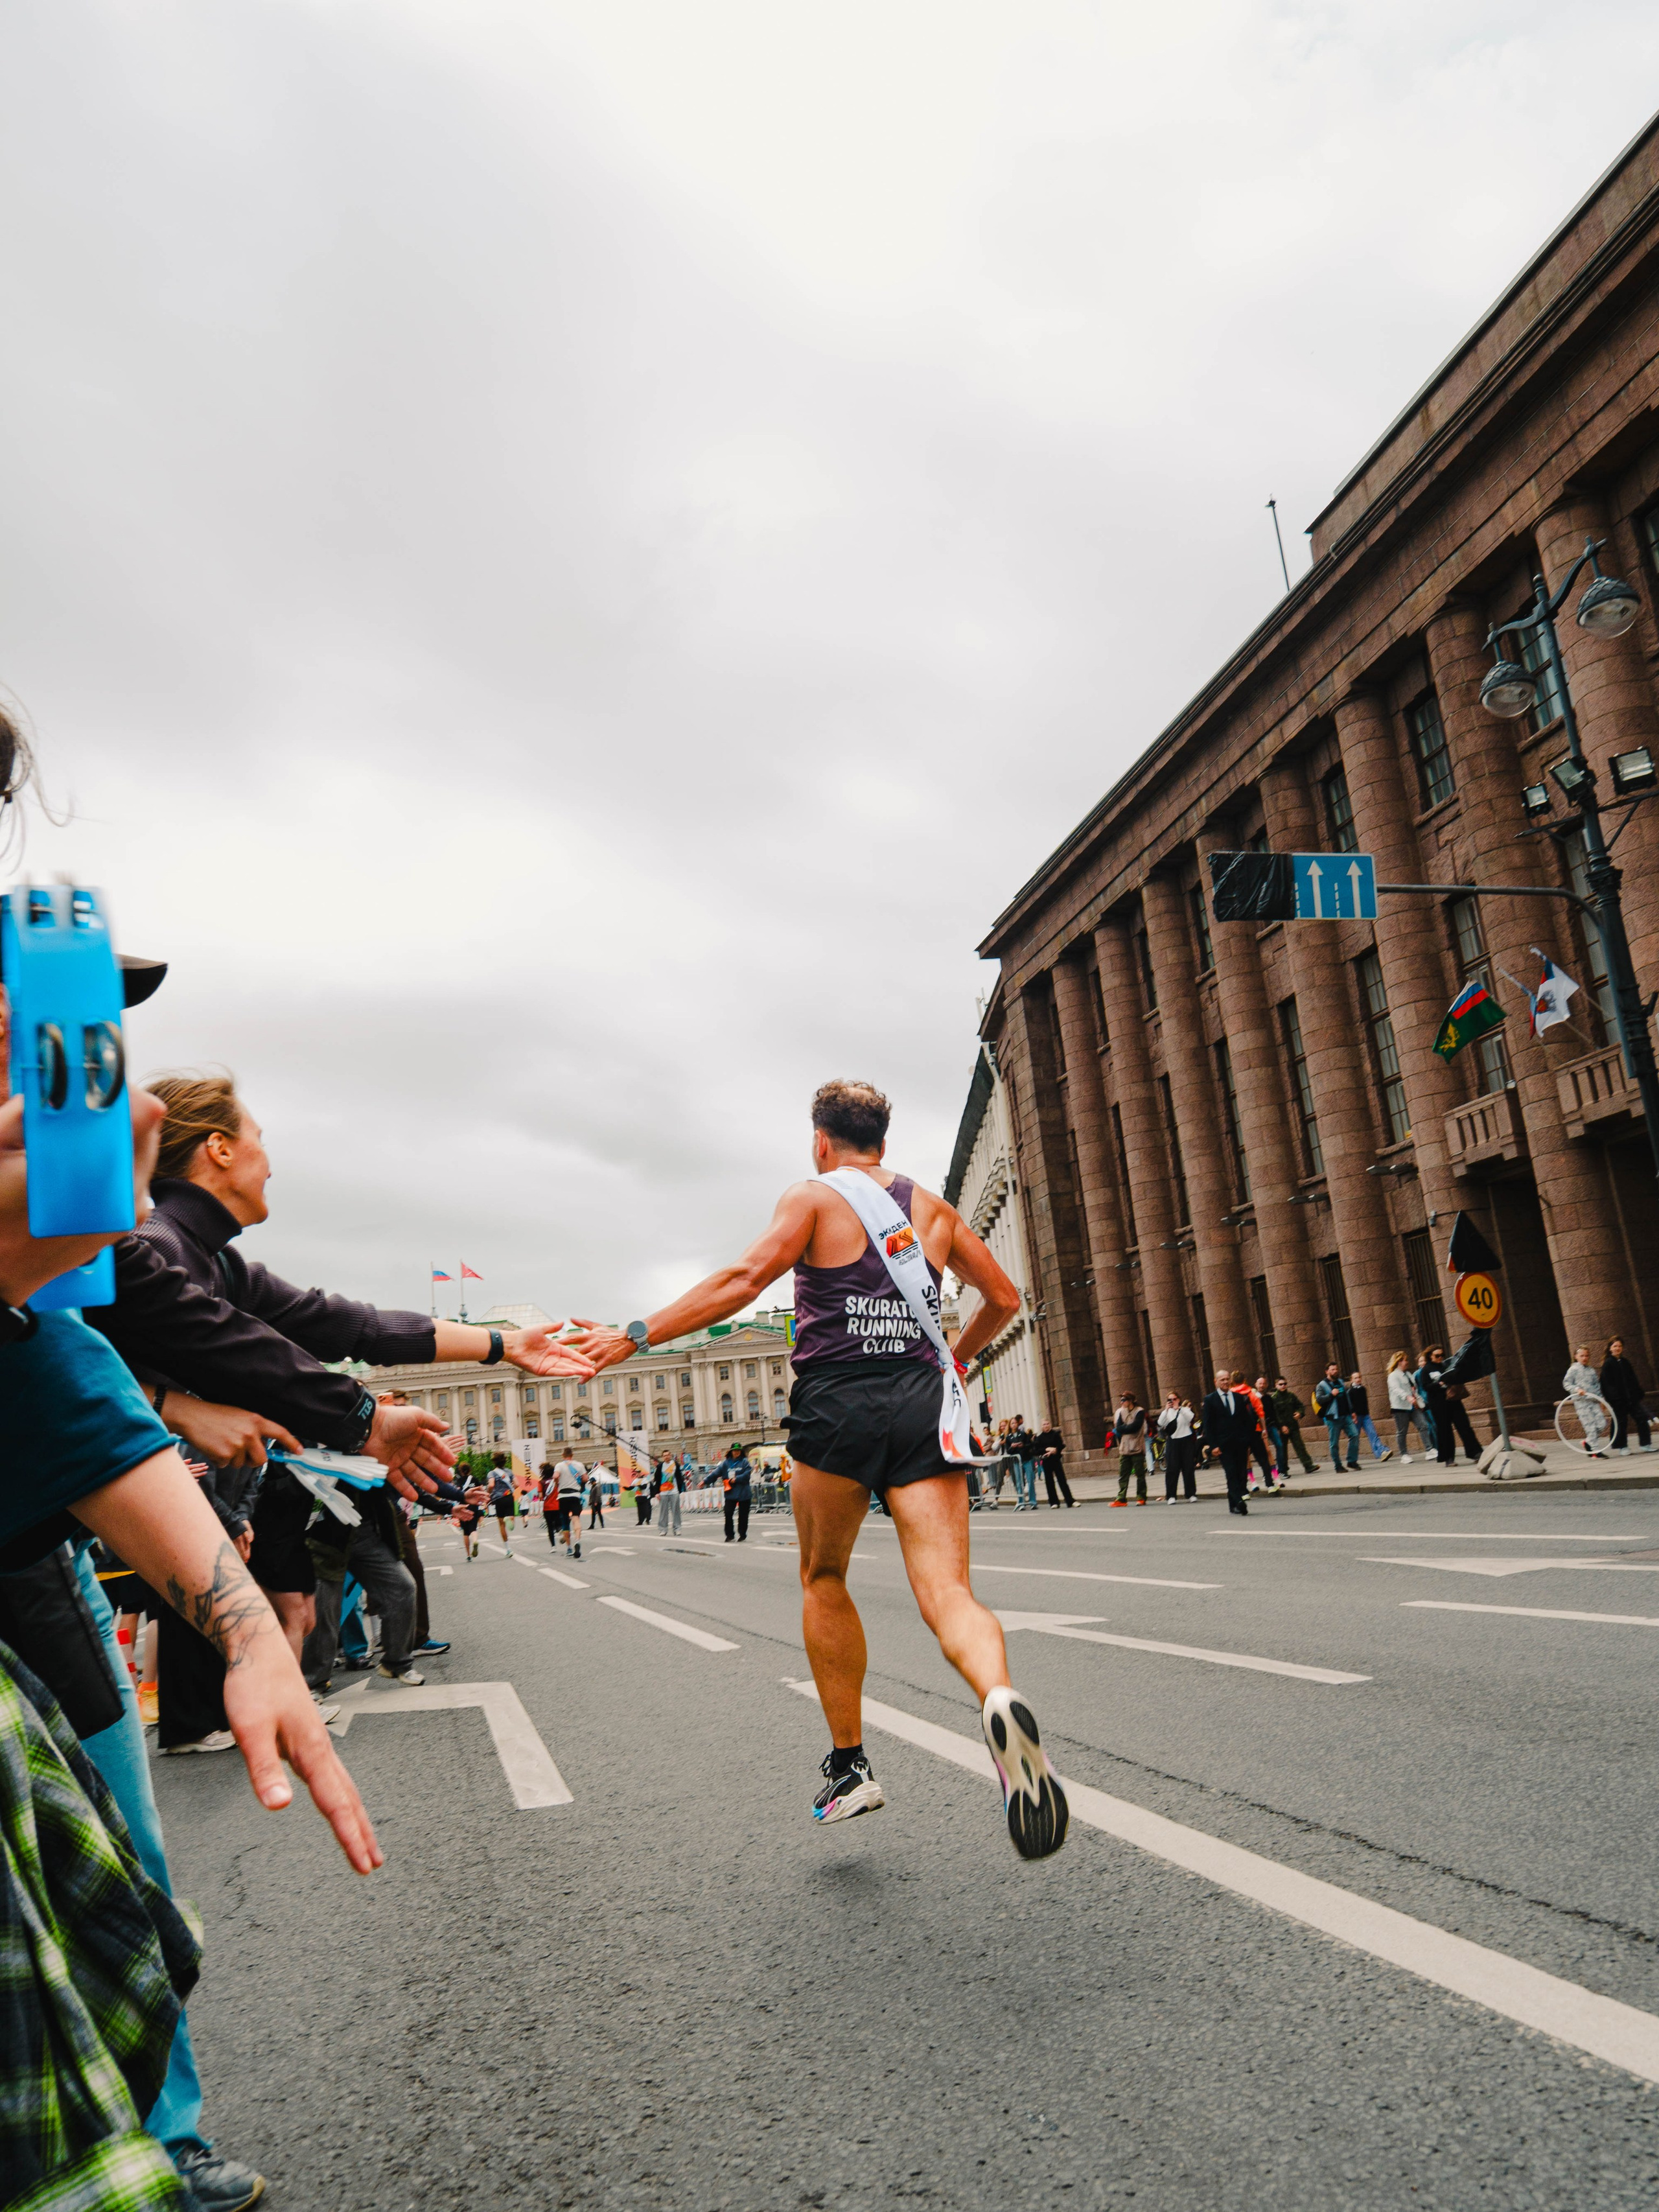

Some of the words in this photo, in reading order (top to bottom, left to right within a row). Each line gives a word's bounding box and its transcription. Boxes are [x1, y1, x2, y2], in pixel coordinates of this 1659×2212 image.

[1468, 1287, 1493, 1309] 40
[846, 1317, 922, 1340] RUNNING
[863, 1338, 906, 1355] CLUB
